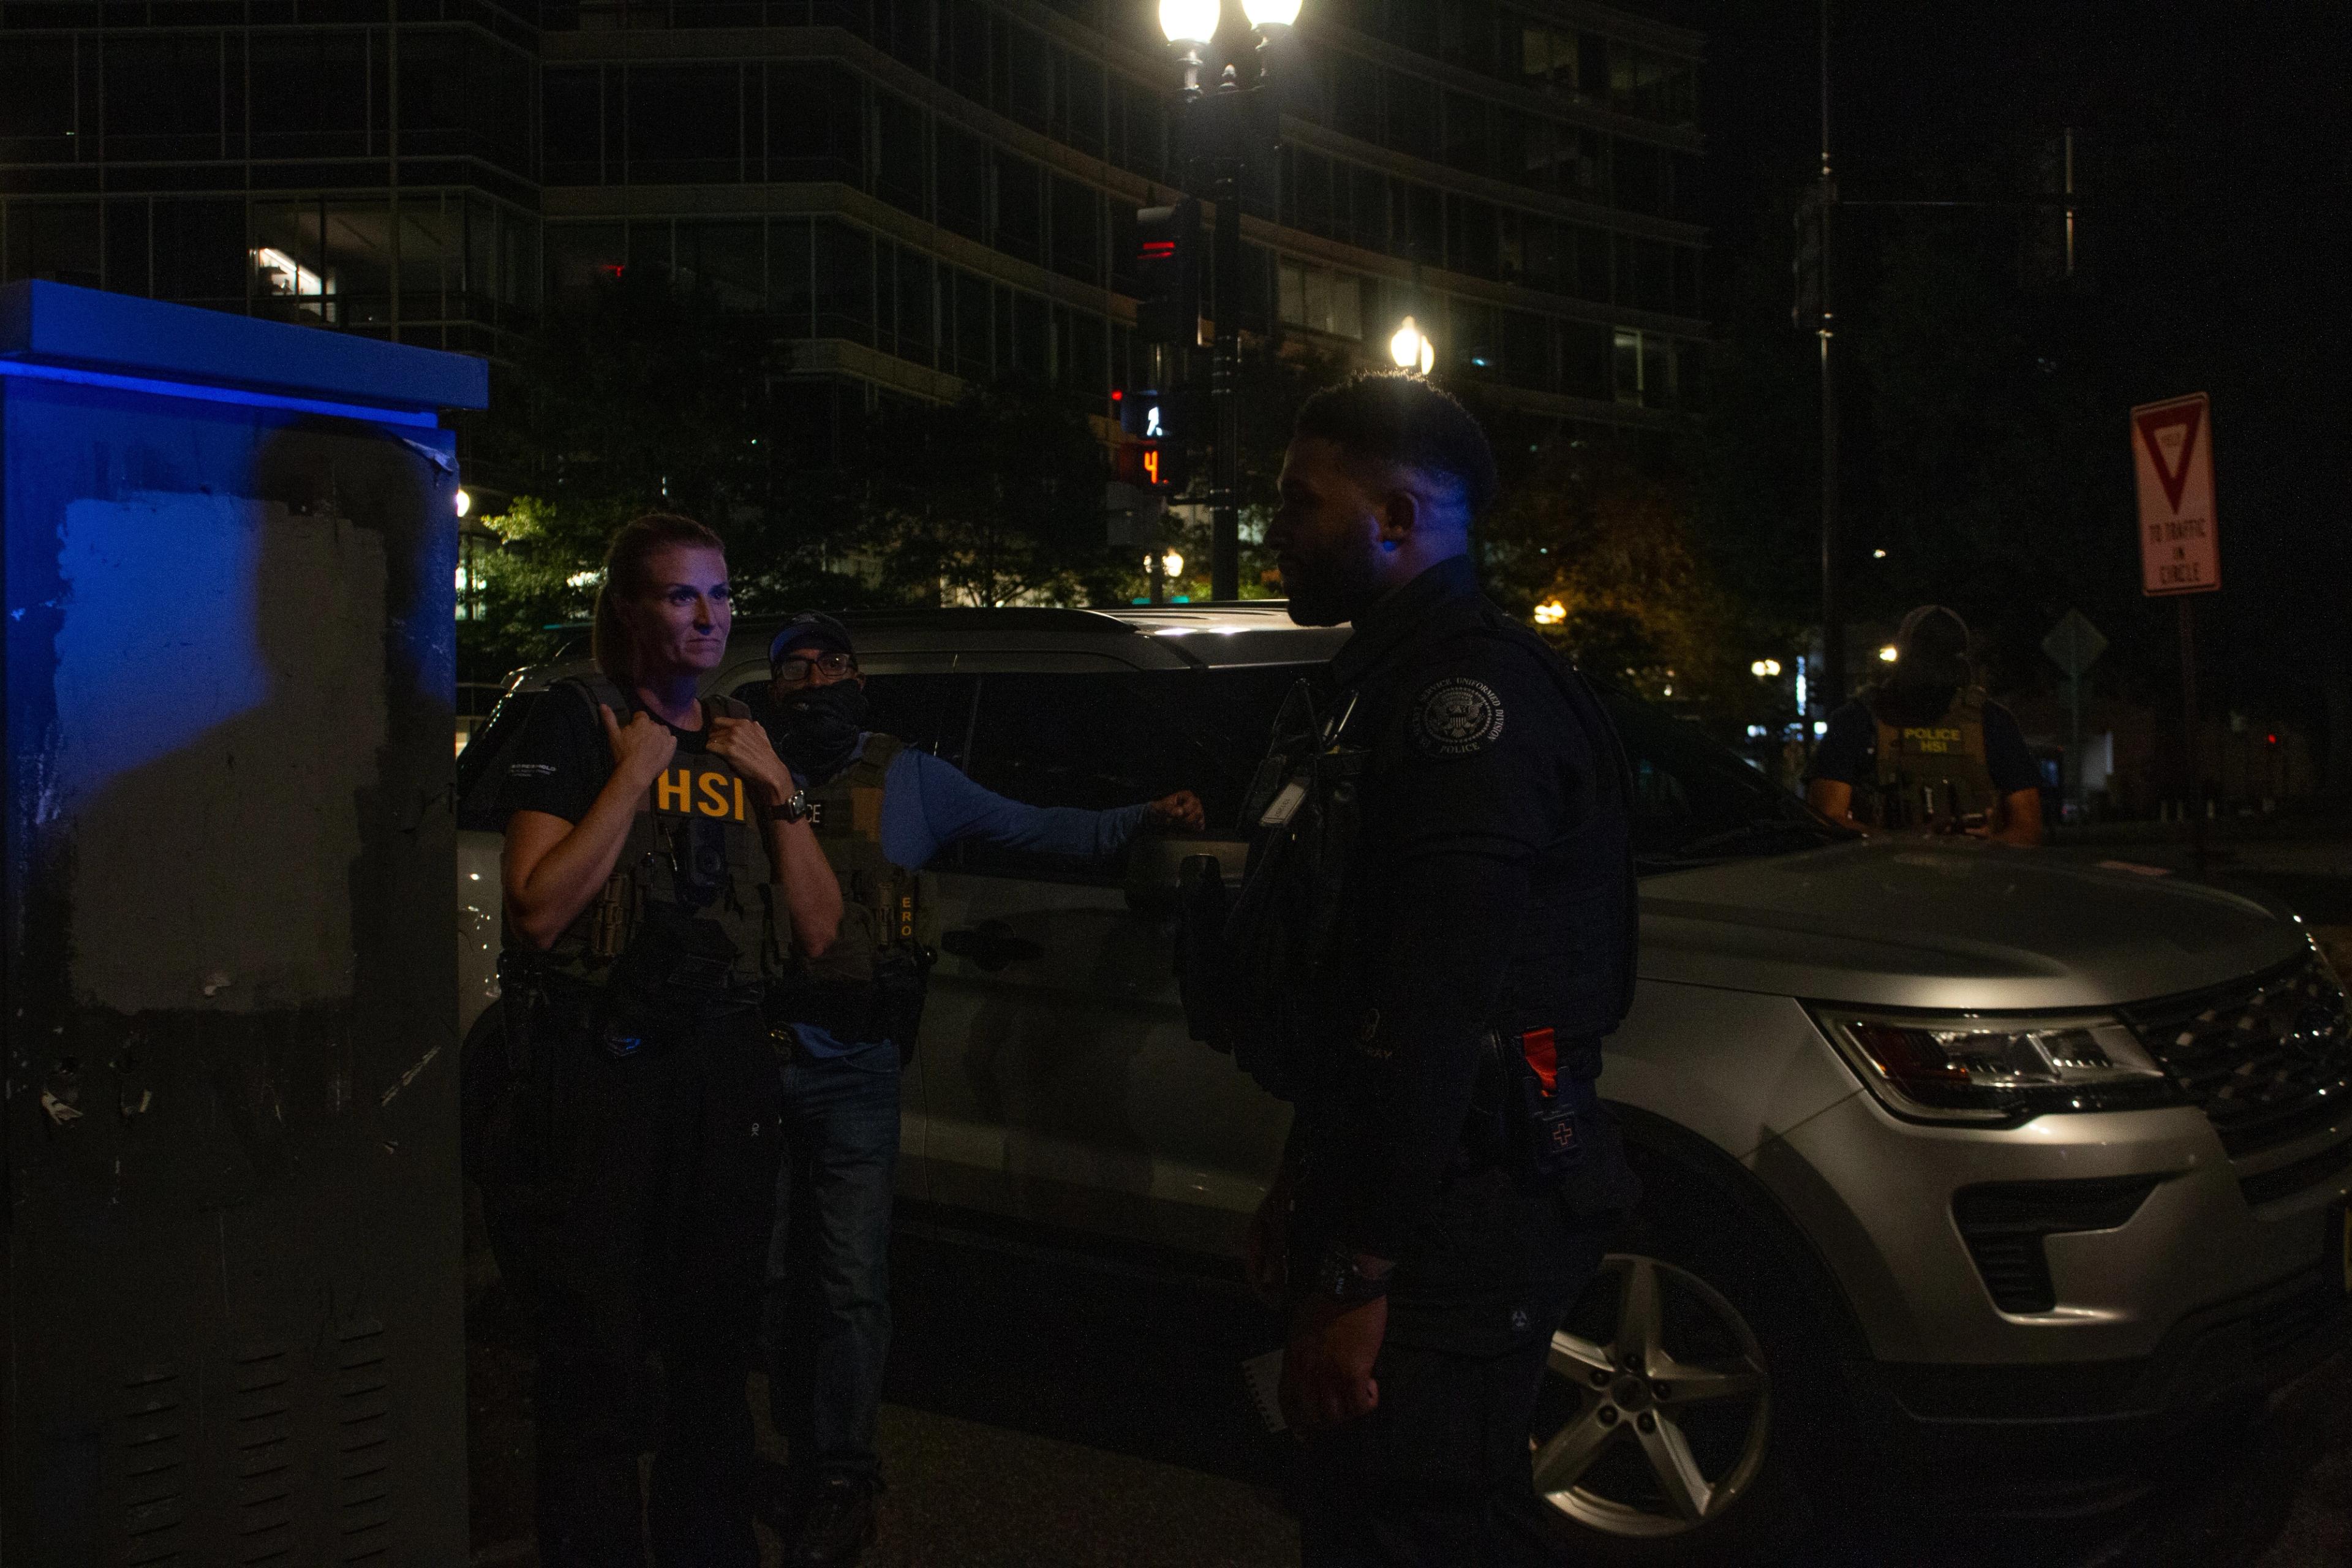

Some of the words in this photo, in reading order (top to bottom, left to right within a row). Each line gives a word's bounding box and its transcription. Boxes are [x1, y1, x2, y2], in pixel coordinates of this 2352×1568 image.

[1144, 450, 1158, 484] 4
[2149, 524, 2161, 543] TO
[2165, 518, 2206, 541] TRAFFIC
[2173, 547, 2185, 559] IN
[2160, 562, 2200, 584] CIRCLE
[1456, 677, 1501, 707] UNIFORMED
[1487, 709, 1504, 742] DIVISION
[1904, 727, 1960, 741] POLICE
[1439, 742, 1480, 754] POLICE
[1921, 741, 1947, 753] HSI
[657, 768, 745, 821] HSI
[902, 897, 912, 937] ERO
